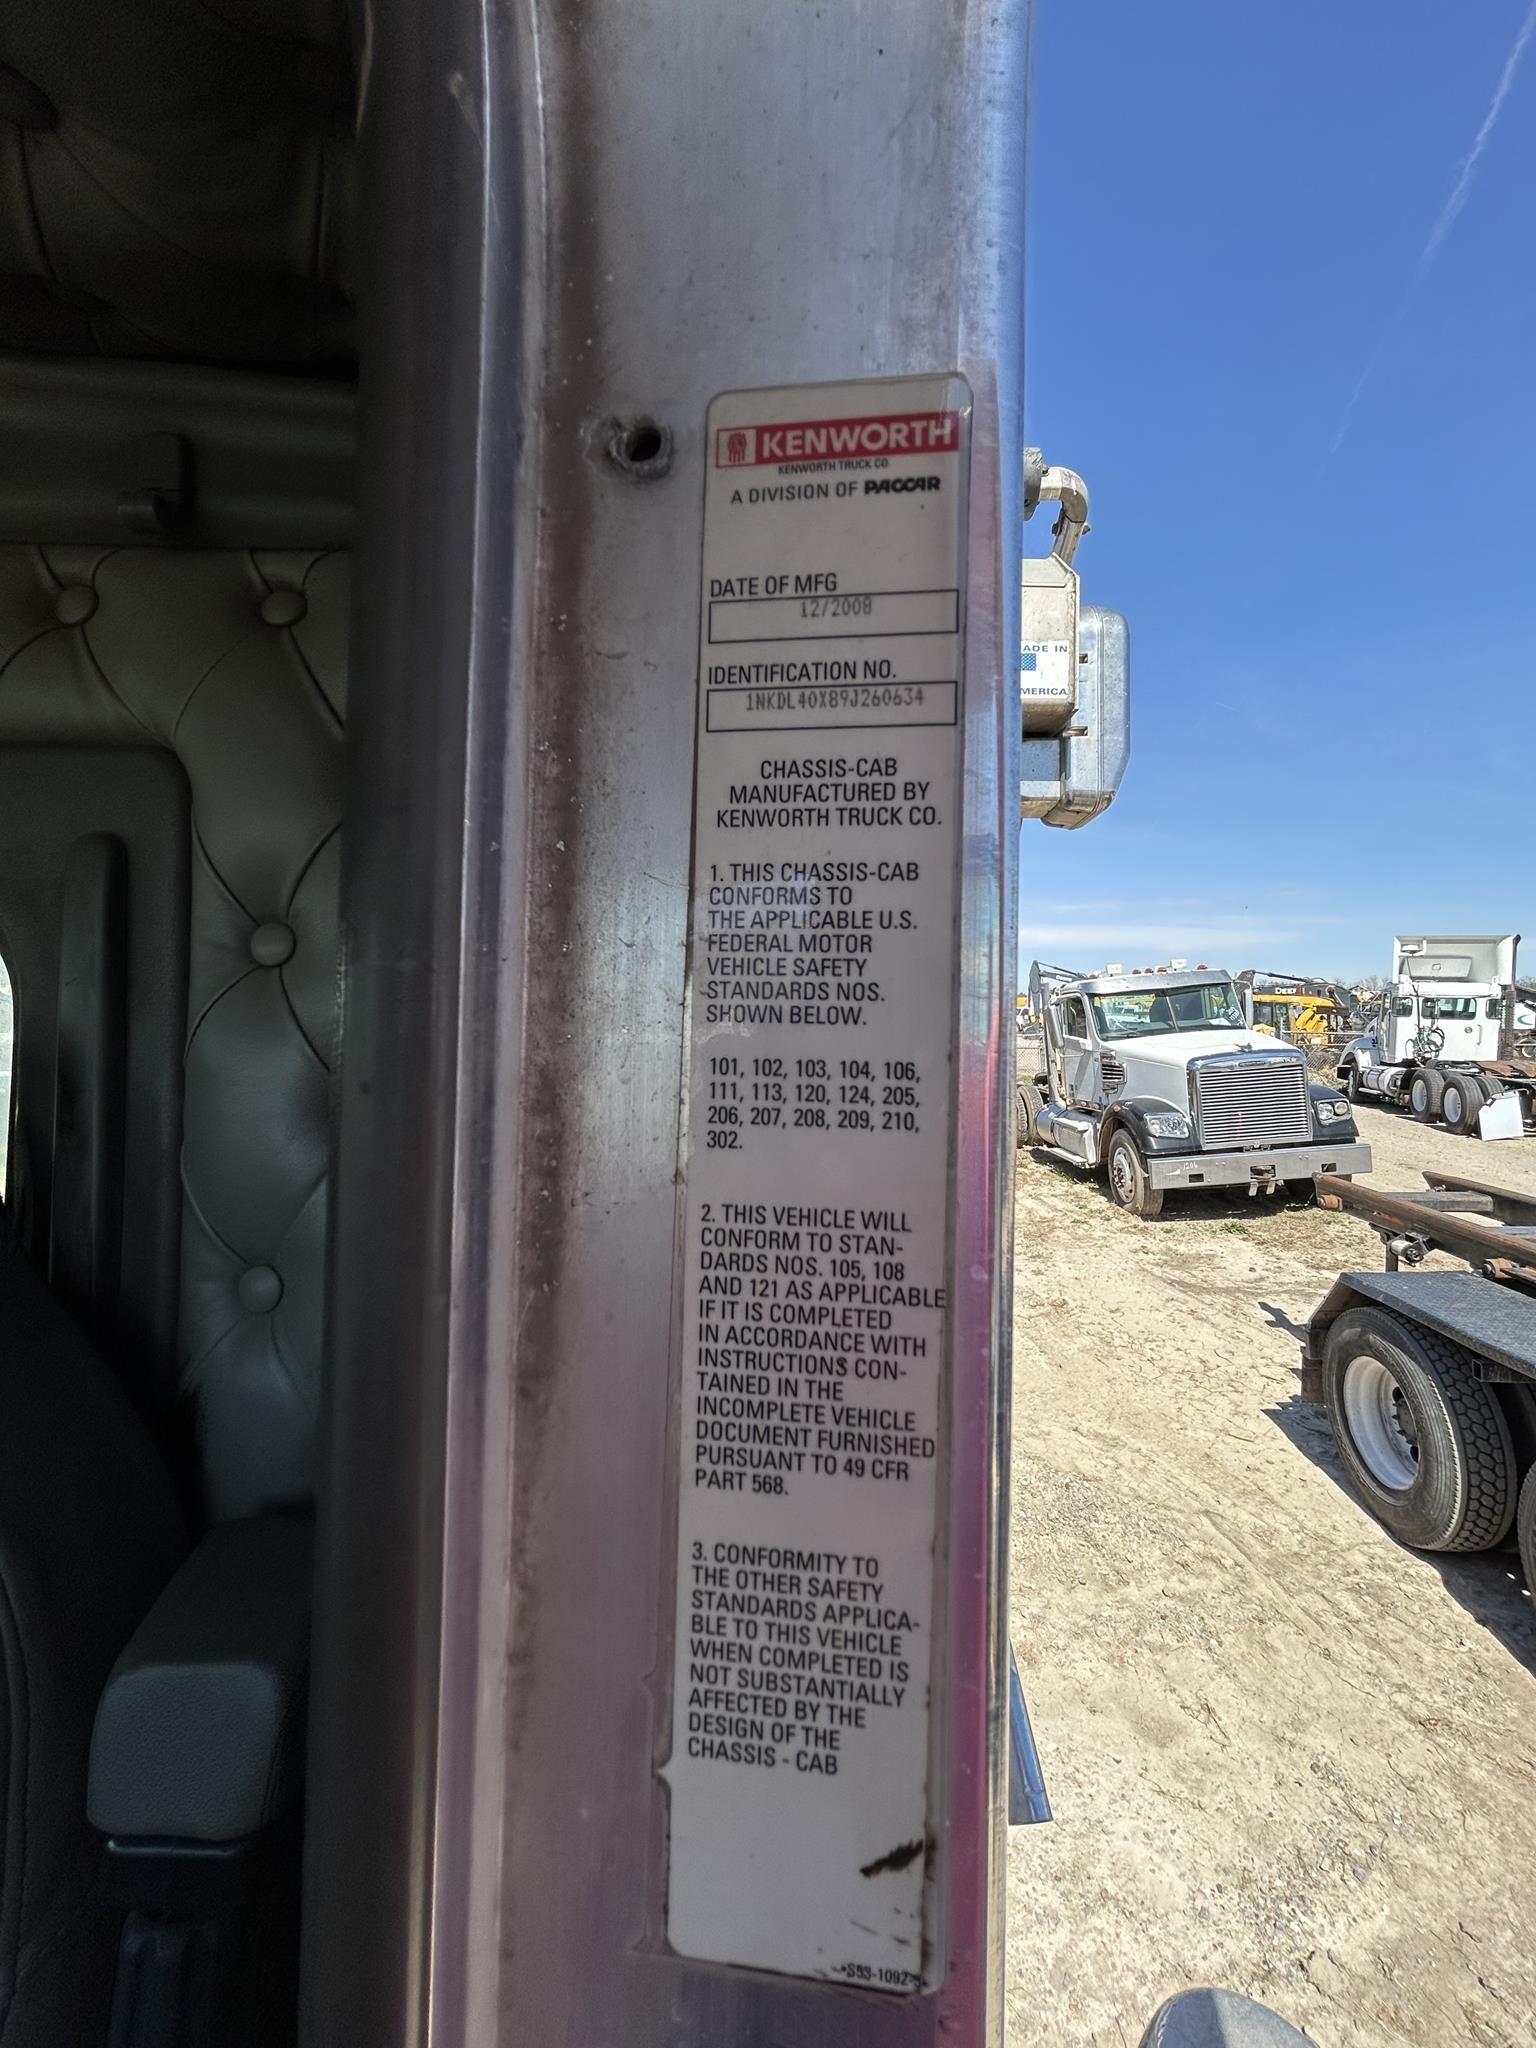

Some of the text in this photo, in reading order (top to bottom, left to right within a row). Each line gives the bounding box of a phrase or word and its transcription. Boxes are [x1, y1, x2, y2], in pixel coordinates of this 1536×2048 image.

[762, 420, 954, 458] KENWORTH
[778, 461, 836, 475] KENWORTH
[838, 459, 872, 471] TRUCK
[731, 477, 941, 504] A DIVISION OF PACCAR
[710, 573, 837, 597] DATE OF MFG
[800, 597, 872, 618] 12/2008
[708, 660, 897, 685] IDENTIFICATION NO.
[760, 758, 897, 779] CHASSIS-CAB
[729, 782, 930, 804] MANUFACTURED BY
[717, 806, 942, 828] KENWORTH TRUCK CO.
[710, 862, 919, 882] 1. THIS CHASSIS-CAB
[709, 887, 852, 906] CONFORMS TO
[708, 910, 918, 929] THE APPLICABLE U.S.
[707, 934, 872, 953] FEDERAL MOTOR
[707, 957, 867, 977] VEHICLE SAFETY
[707, 981, 885, 1002] STANDARDS NOS.
[706, 1004, 867, 1025] SHOWN BELOW.
[710, 1057, 920, 1083] 101, 102, 103, 104, 106,
[709, 1082, 920, 1108] 111, 113, 120, 124, 205,
[708, 1106, 920, 1134] 206, 207, 208, 209, 210,
[707, 1130, 743, 1149] 302.
[701, 1204, 911, 1232] 2. THIS VEHICLE WILL
[701, 1228, 904, 1256] CONFORM TO STAN-
[701, 1252, 904, 1281] DARDS NOS. 105, 108
[699, 1276, 946, 1309] AND 121 AS APPLICABLE
[699, 1299, 891, 1330] IF IT IS COMPLETED
[699, 1324, 926, 1357] IN ACCORDANCE WITH
[698, 1348, 907, 1380] INSTRUCTIONS CON-
[697, 1372, 844, 1401] TAINED IN THE
[697, 1396, 916, 1432] INCOMPLETE VEHICLE
[697, 1421, 935, 1458] DOCUMENT FURNISHED
[696, 1445, 909, 1481] PURSUANT TO 49 CFR
[695, 1469, 789, 1495] PART 568.
[692, 1542, 879, 1578] 3. CONFORMITY TO
[692, 1565, 884, 1603] THE OTHER SAFETY
[691, 1590, 920, 1632] STANDARDS APPLICA-
[691, 1614, 901, 1656] BLE TO THIS VEHICLE
[690, 1638, 909, 1682] WHEN COMPLETED IS
[690, 1664, 905, 1708] NOT SUBSTANTIALLY
[689, 1688, 866, 1728] AFFECTED BY THE
[689, 1712, 841, 1751] DESIGN OF THE
